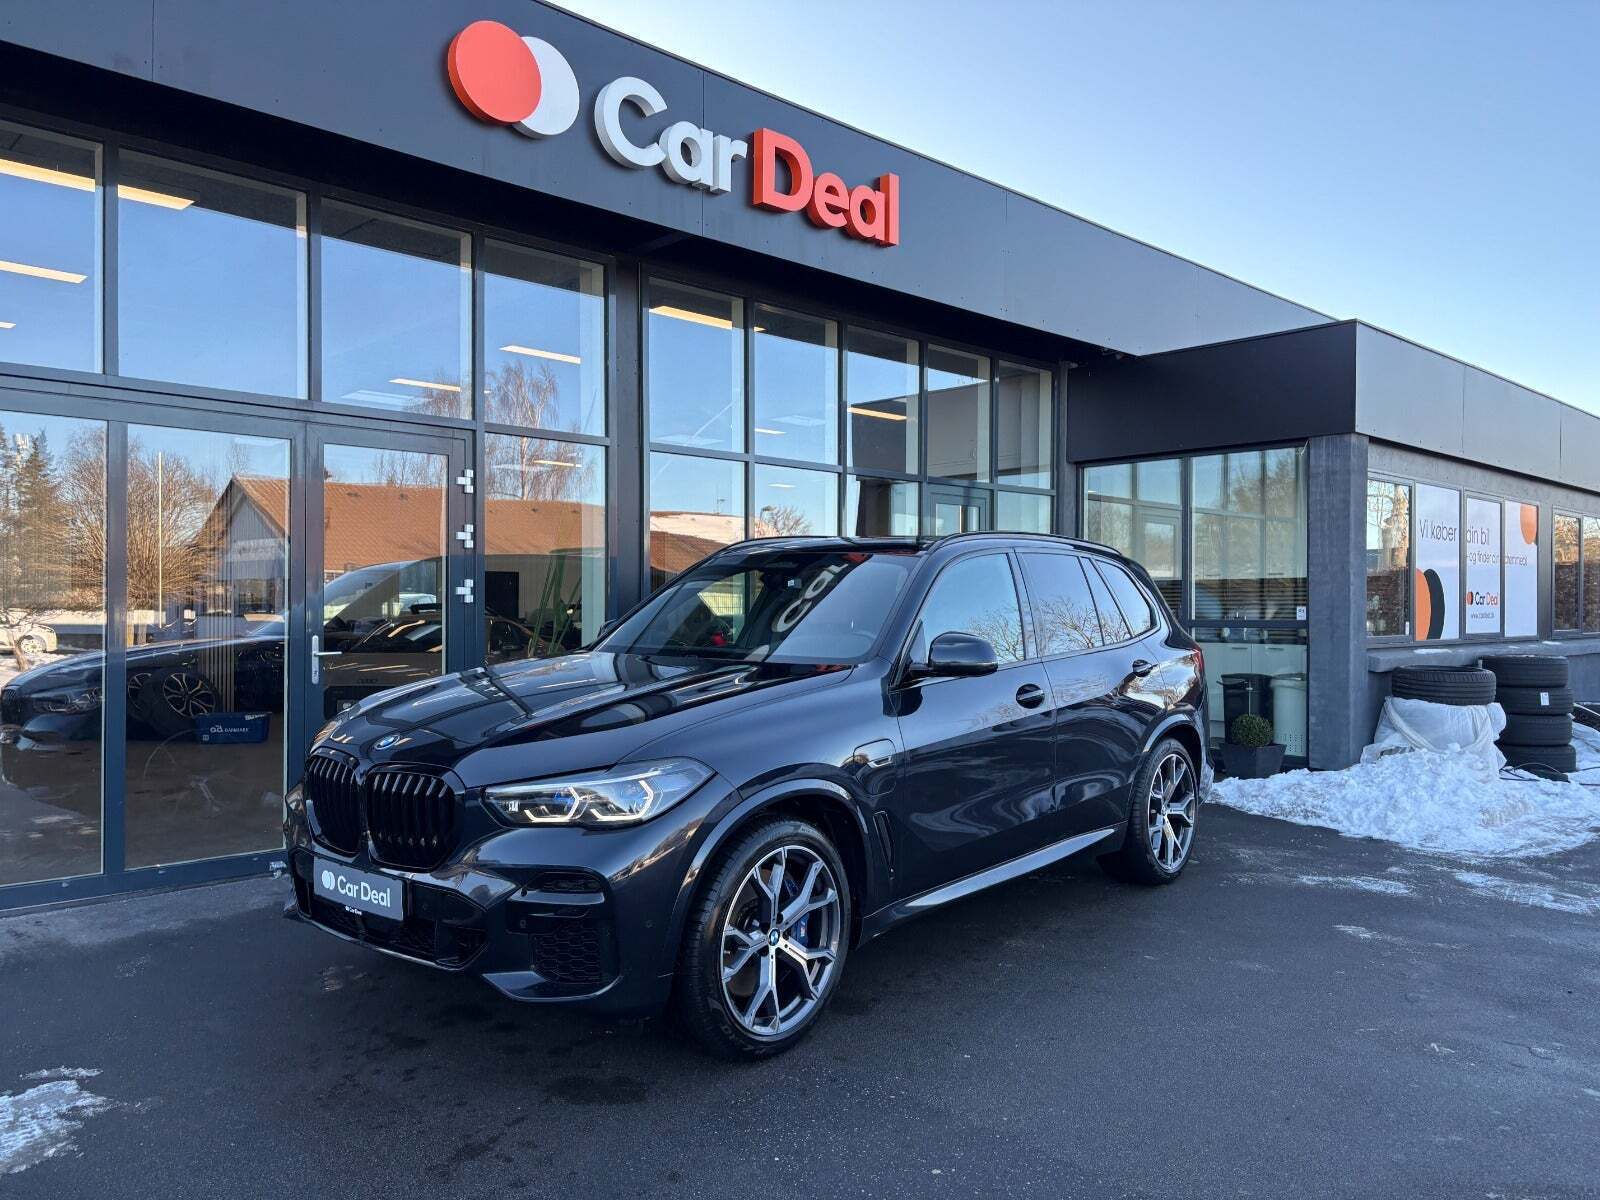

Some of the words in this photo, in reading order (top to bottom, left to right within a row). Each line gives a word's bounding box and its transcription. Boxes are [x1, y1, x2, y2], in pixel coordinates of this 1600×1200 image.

[595, 76, 748, 194] Car
[753, 127, 900, 247] Deal
[1420, 519, 1429, 539] Vi
[1431, 520, 1457, 541] køber
[1475, 591, 1485, 606] Car
[1486, 591, 1498, 606] Deal
[337, 875, 359, 898] Car
[360, 881, 391, 908] Deal
